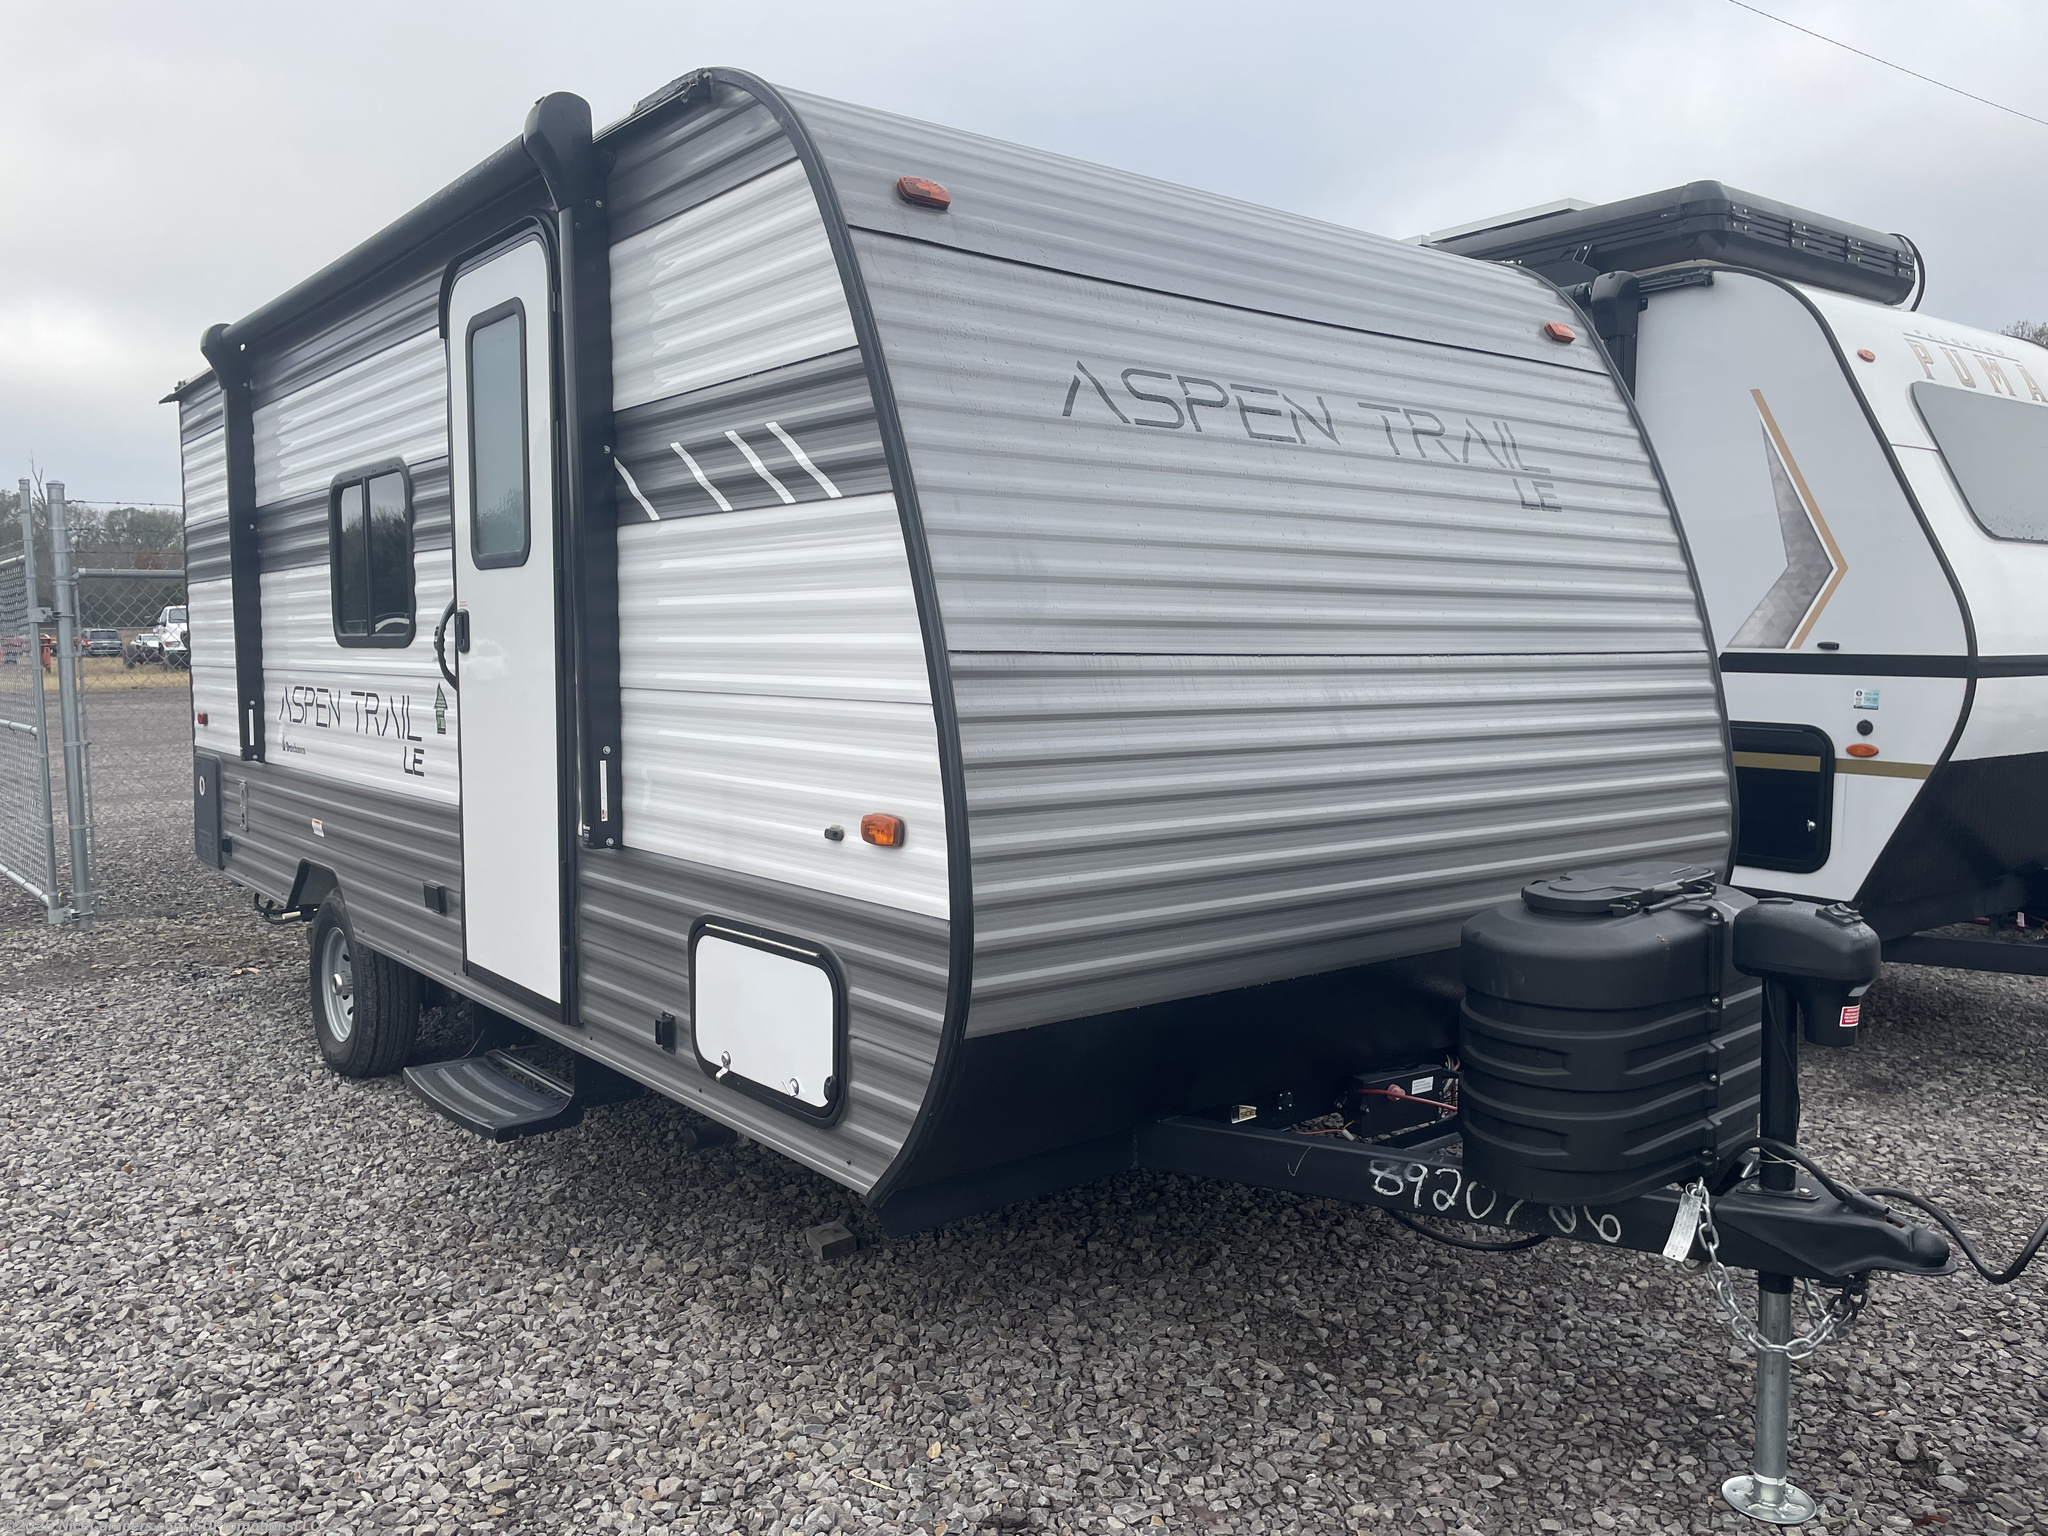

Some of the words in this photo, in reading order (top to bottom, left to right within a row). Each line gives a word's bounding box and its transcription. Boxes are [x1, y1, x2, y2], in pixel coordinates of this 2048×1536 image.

[1904, 338, 2048, 403] PUMA
[1062, 361, 1342, 445] ASPEN
[1357, 401, 1551, 474] TRAIL
[1512, 478, 1562, 512] LE
[279, 686, 341, 728] ASPEN
[350, 691, 422, 742] TRAIL
[402, 746, 425, 777] LE
